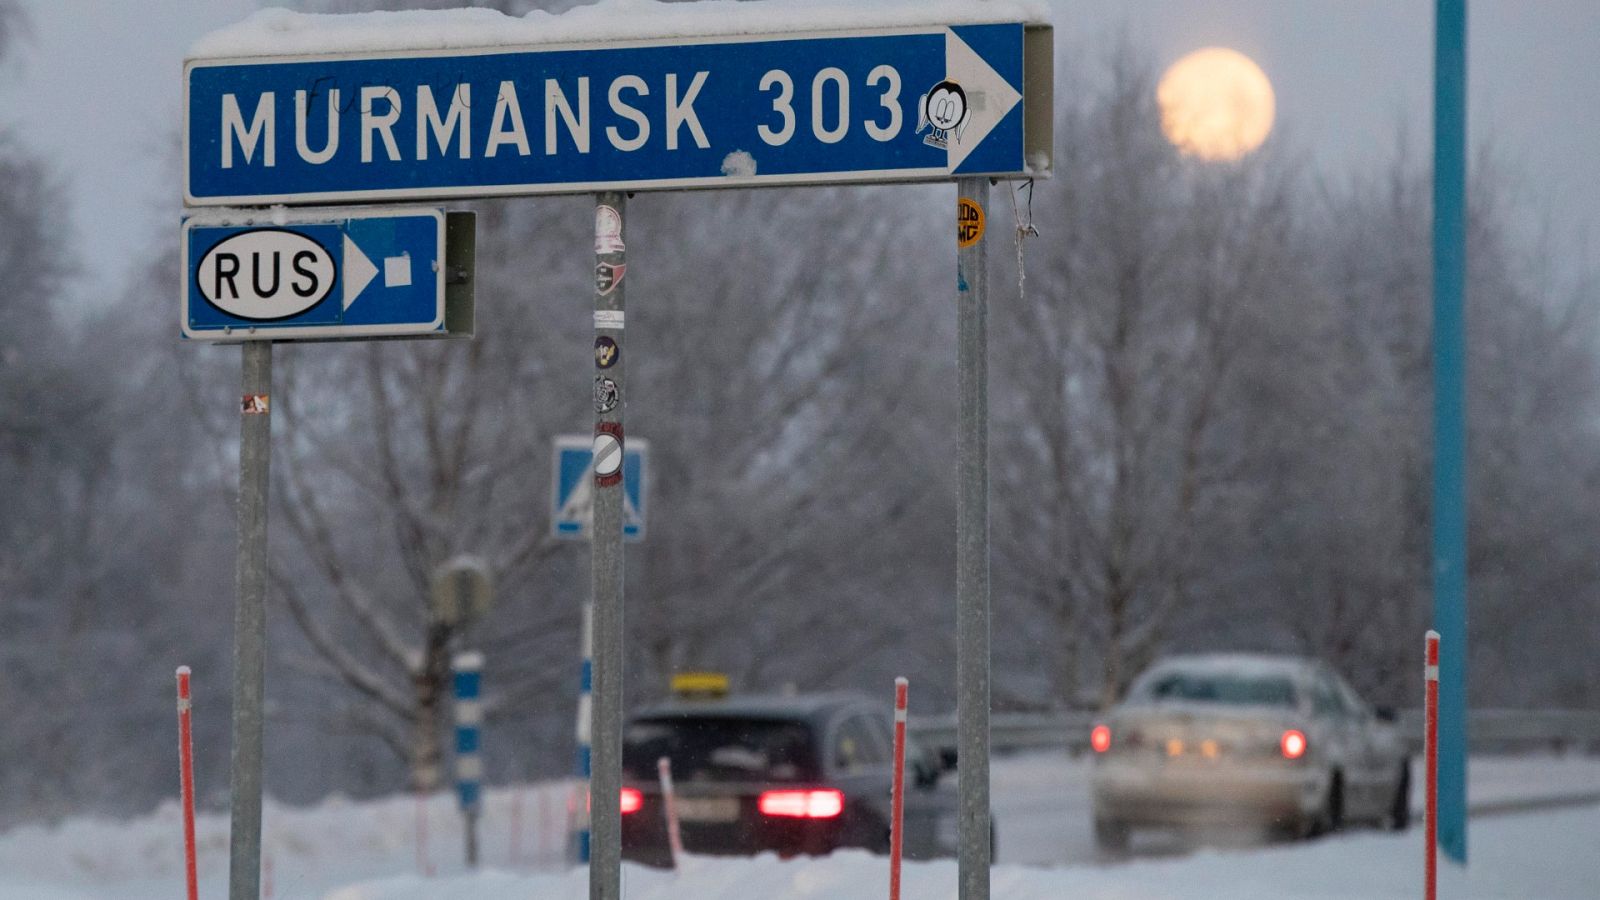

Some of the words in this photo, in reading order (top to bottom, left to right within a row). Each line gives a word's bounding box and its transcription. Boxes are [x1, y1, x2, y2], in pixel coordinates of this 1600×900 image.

[222, 72, 710, 168] MURMANSK
[758, 65, 902, 145] 303
[214, 250, 320, 301] RUS
